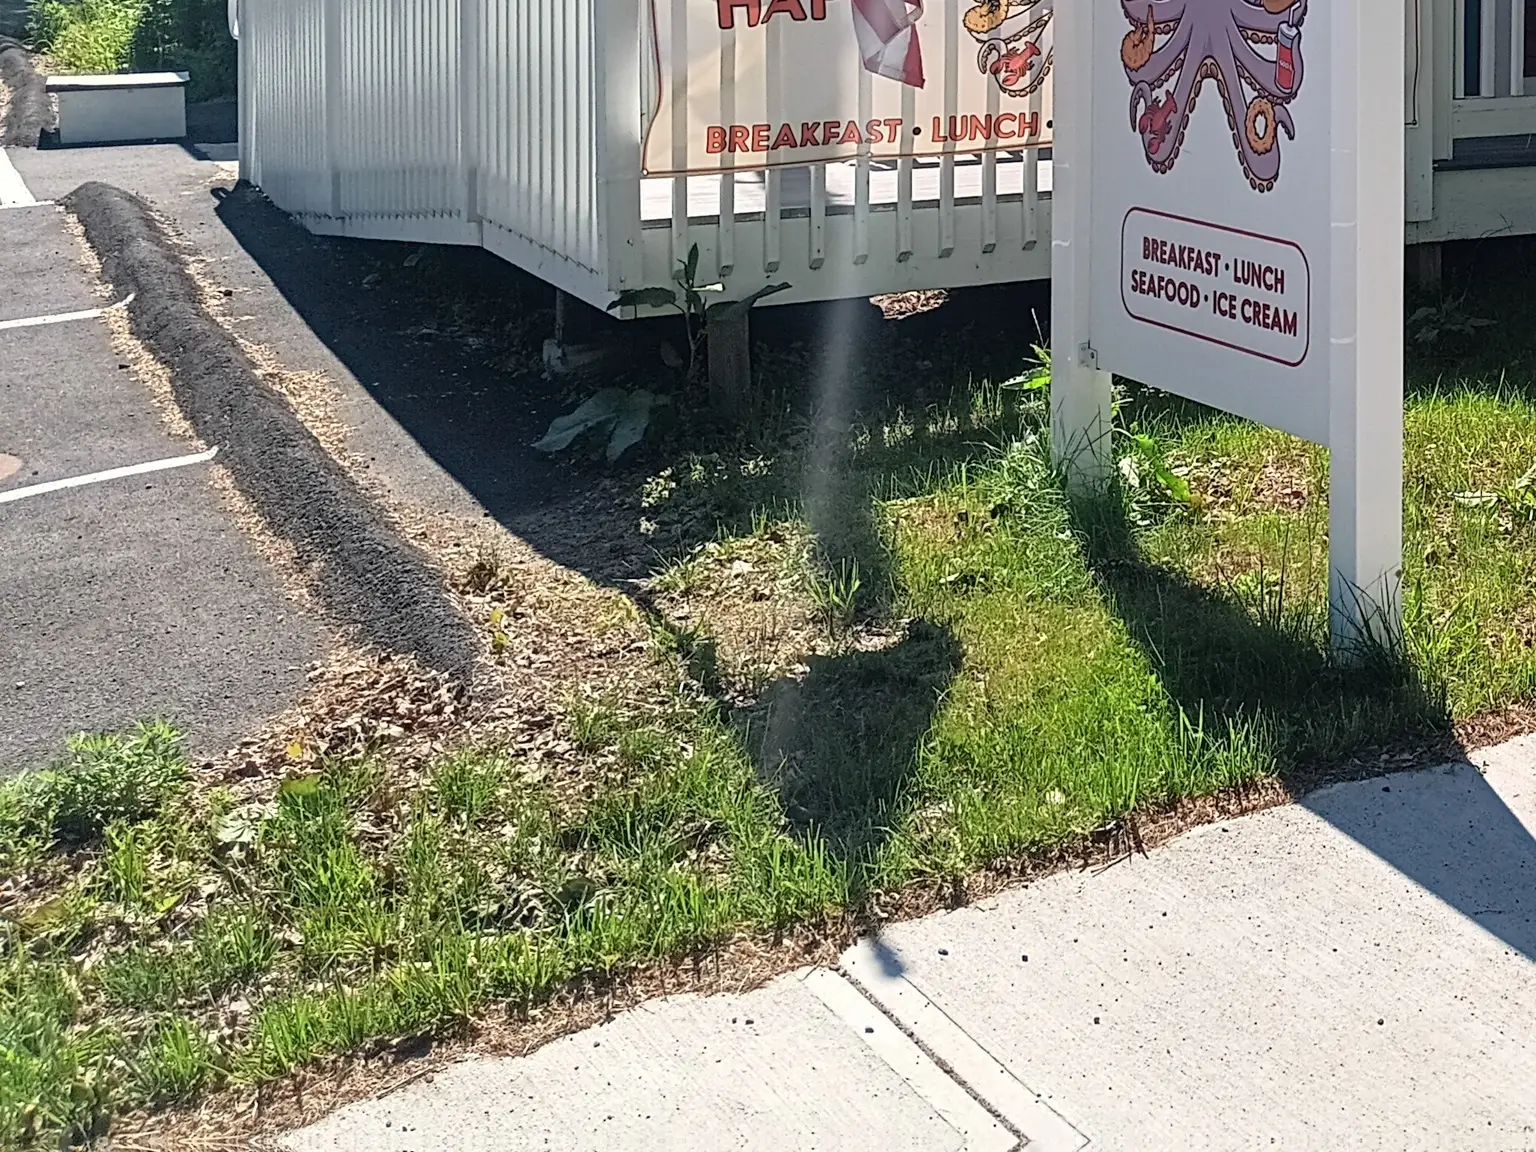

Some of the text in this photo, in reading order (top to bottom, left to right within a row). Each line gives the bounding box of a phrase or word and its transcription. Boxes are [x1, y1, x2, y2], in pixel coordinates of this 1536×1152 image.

[706, 111, 1039, 154] BREAKFAST LUNCH
[1142, 236, 1285, 295] BREAKFAST LUNCH
[1130, 268, 1298, 338] SEAFOOD ICE CREAM
